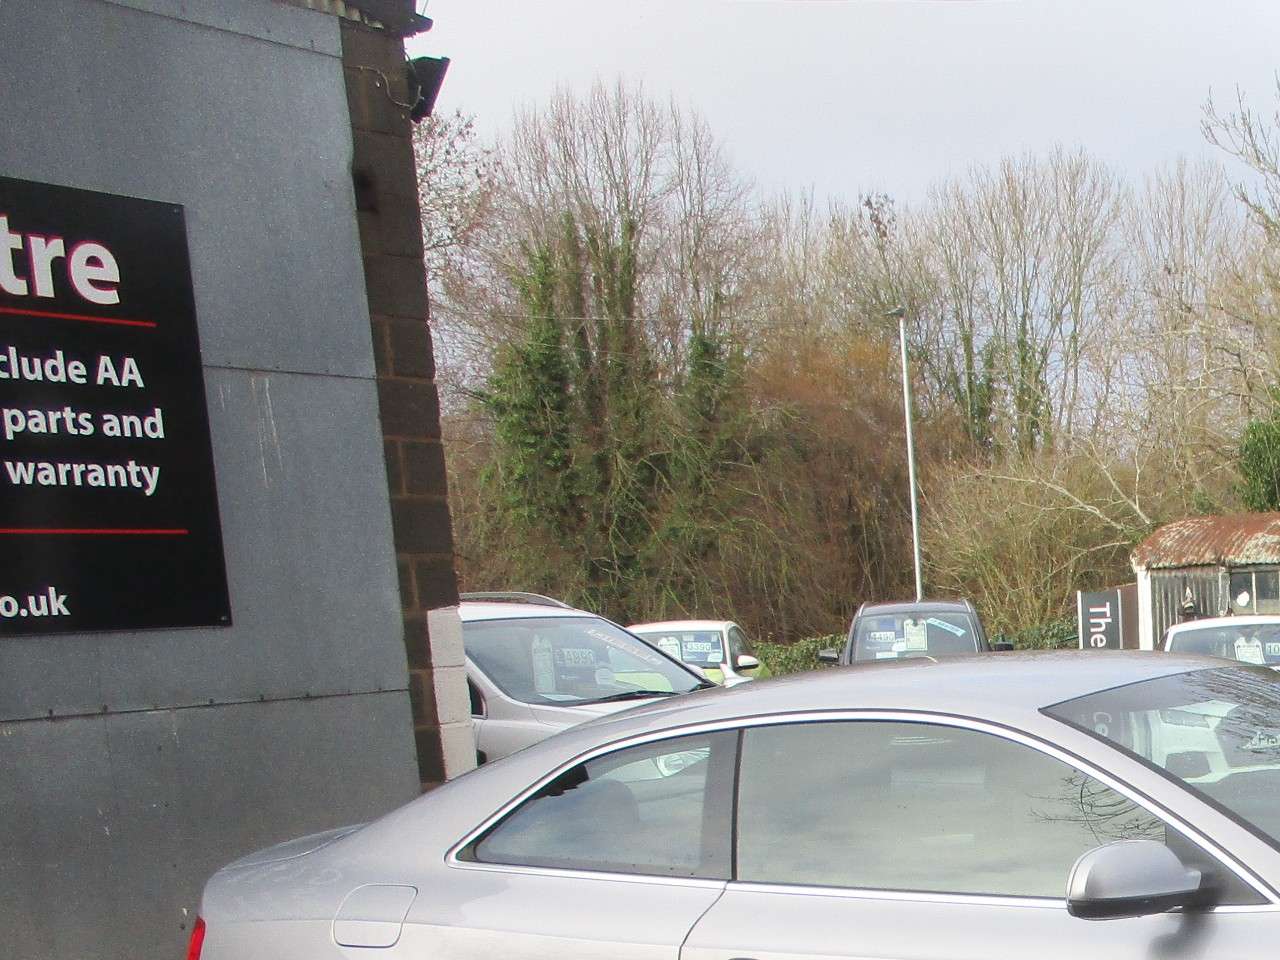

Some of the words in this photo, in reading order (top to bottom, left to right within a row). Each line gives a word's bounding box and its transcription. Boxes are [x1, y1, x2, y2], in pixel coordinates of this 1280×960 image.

[0, 215, 120, 305] tre
[96, 355, 145, 388] AA
[2, 406, 95, 440] parts
[102, 407, 165, 439] and
[4, 460, 160, 496] warranty
[1089, 601, 1112, 648] The
